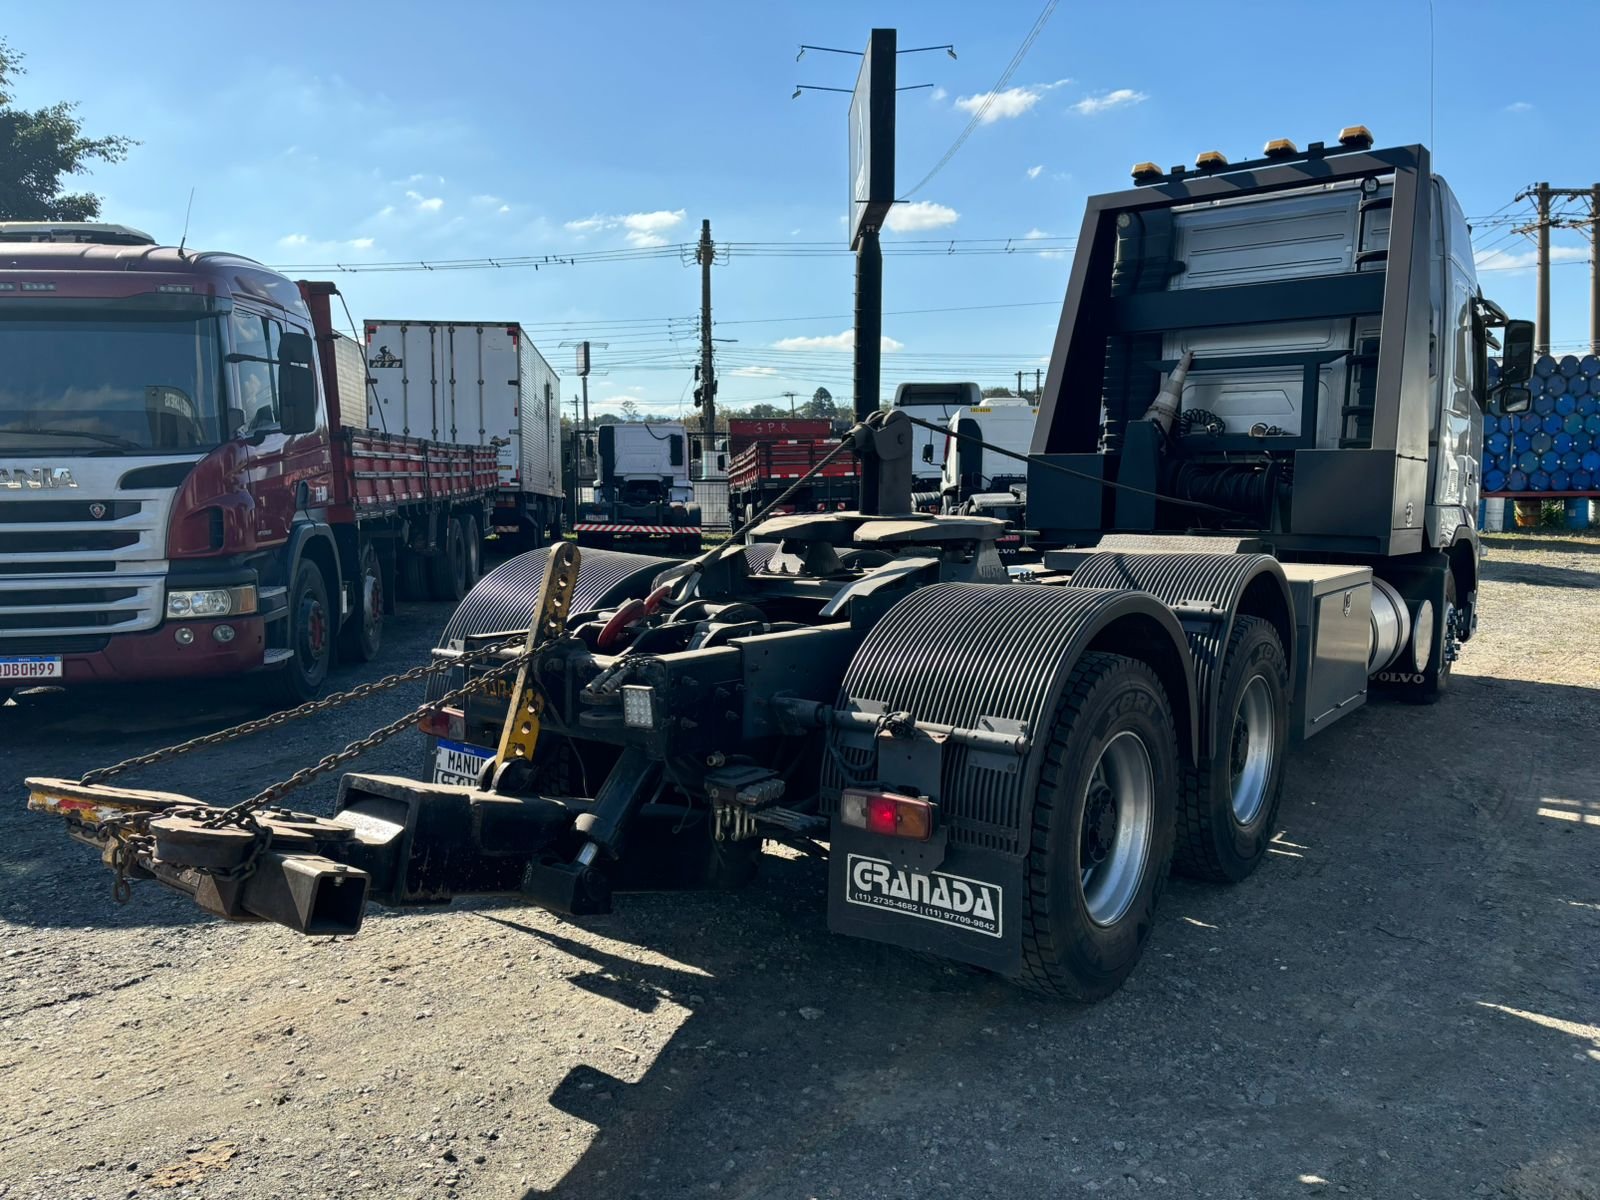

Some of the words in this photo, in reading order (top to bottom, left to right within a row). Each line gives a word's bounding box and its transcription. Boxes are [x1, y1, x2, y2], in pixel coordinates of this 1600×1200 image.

[0, 662, 55, 676] DB0H99
[853, 861, 996, 921] GRANADA
[855, 892, 871, 903] (11)
[925, 907, 942, 919] (11)
[944, 912, 996, 931] 97709-9842
